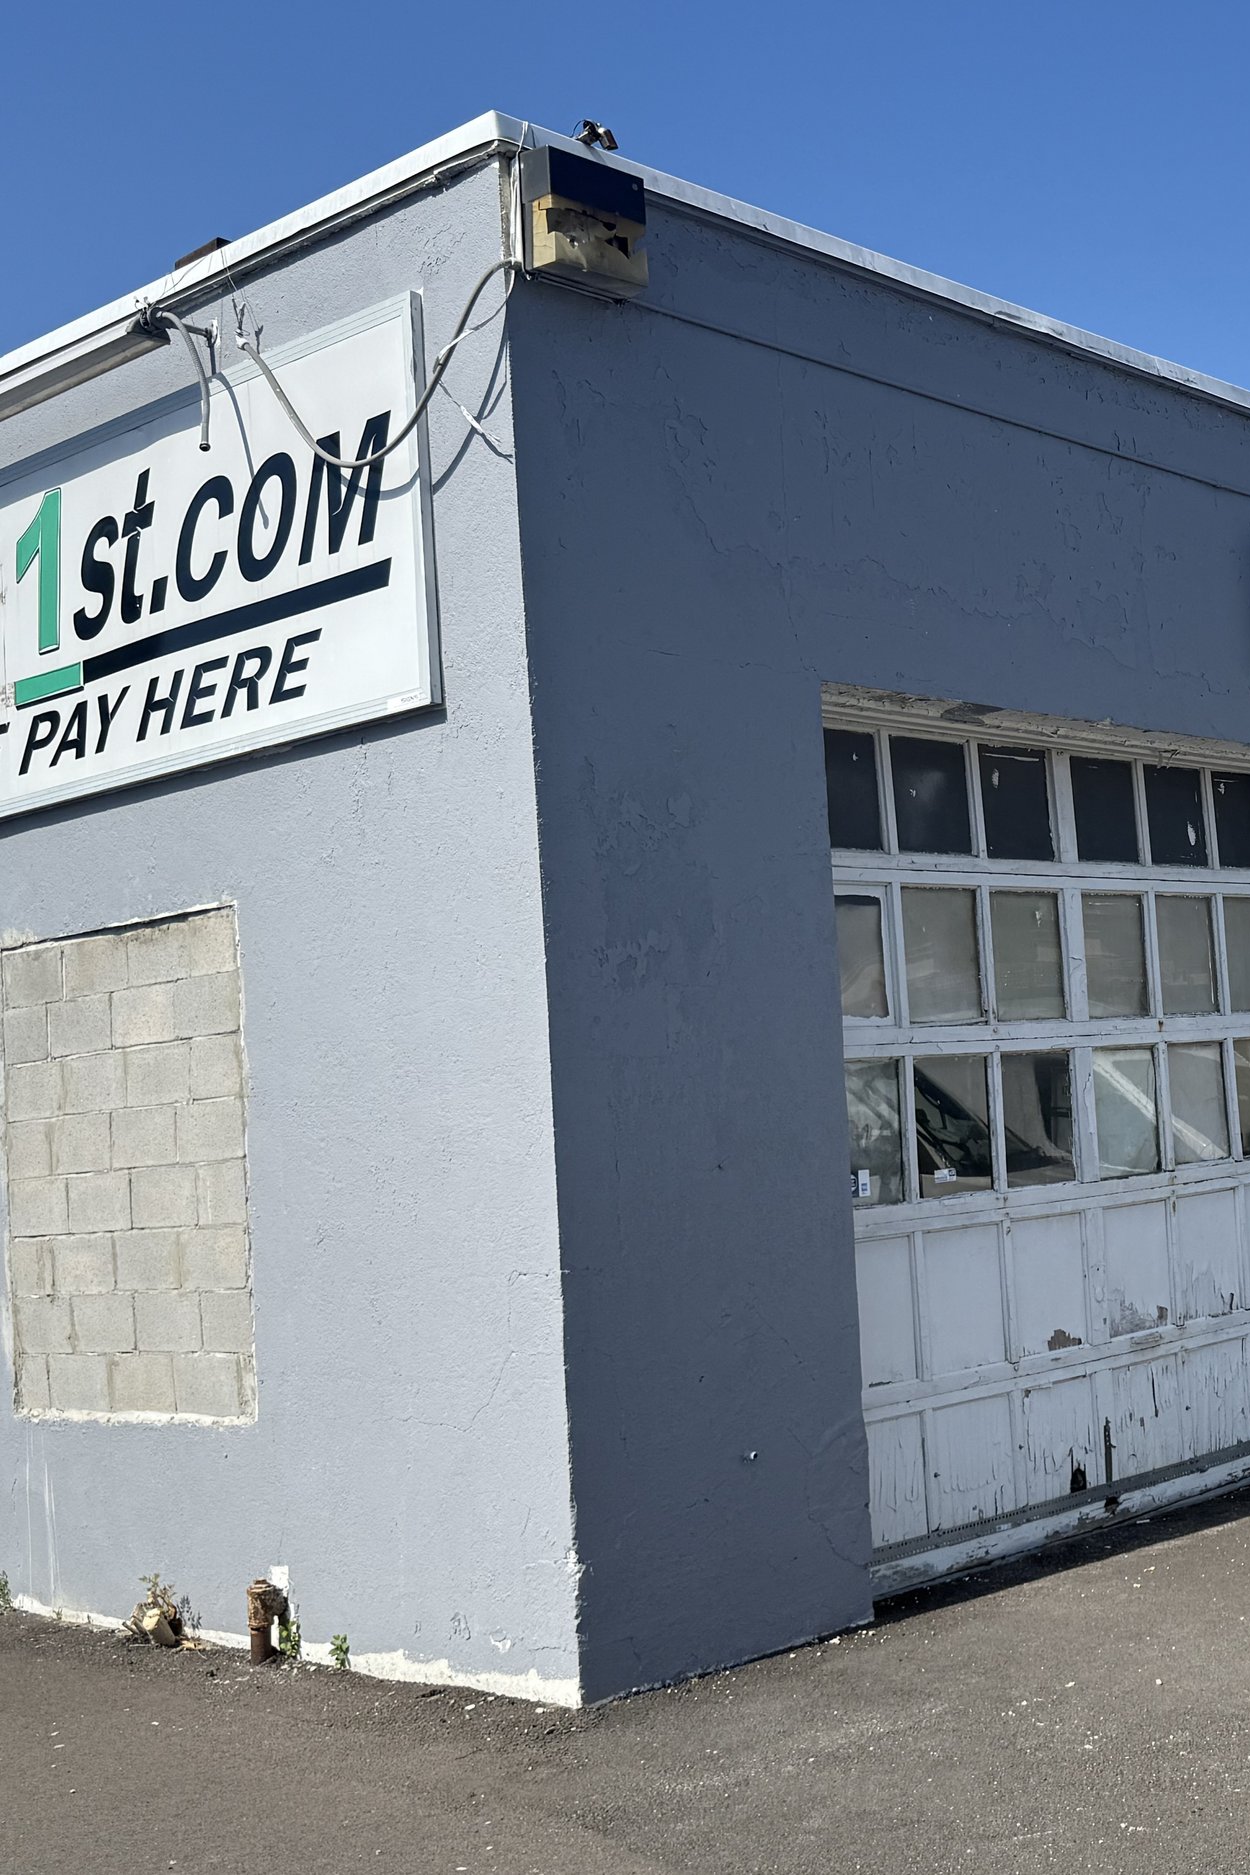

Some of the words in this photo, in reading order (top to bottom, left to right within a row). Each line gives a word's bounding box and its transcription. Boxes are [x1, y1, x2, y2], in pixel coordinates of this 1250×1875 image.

[16, 410, 391, 653] 1st.COM
[18, 684, 130, 776] PAY
[136, 628, 323, 742] HERE
